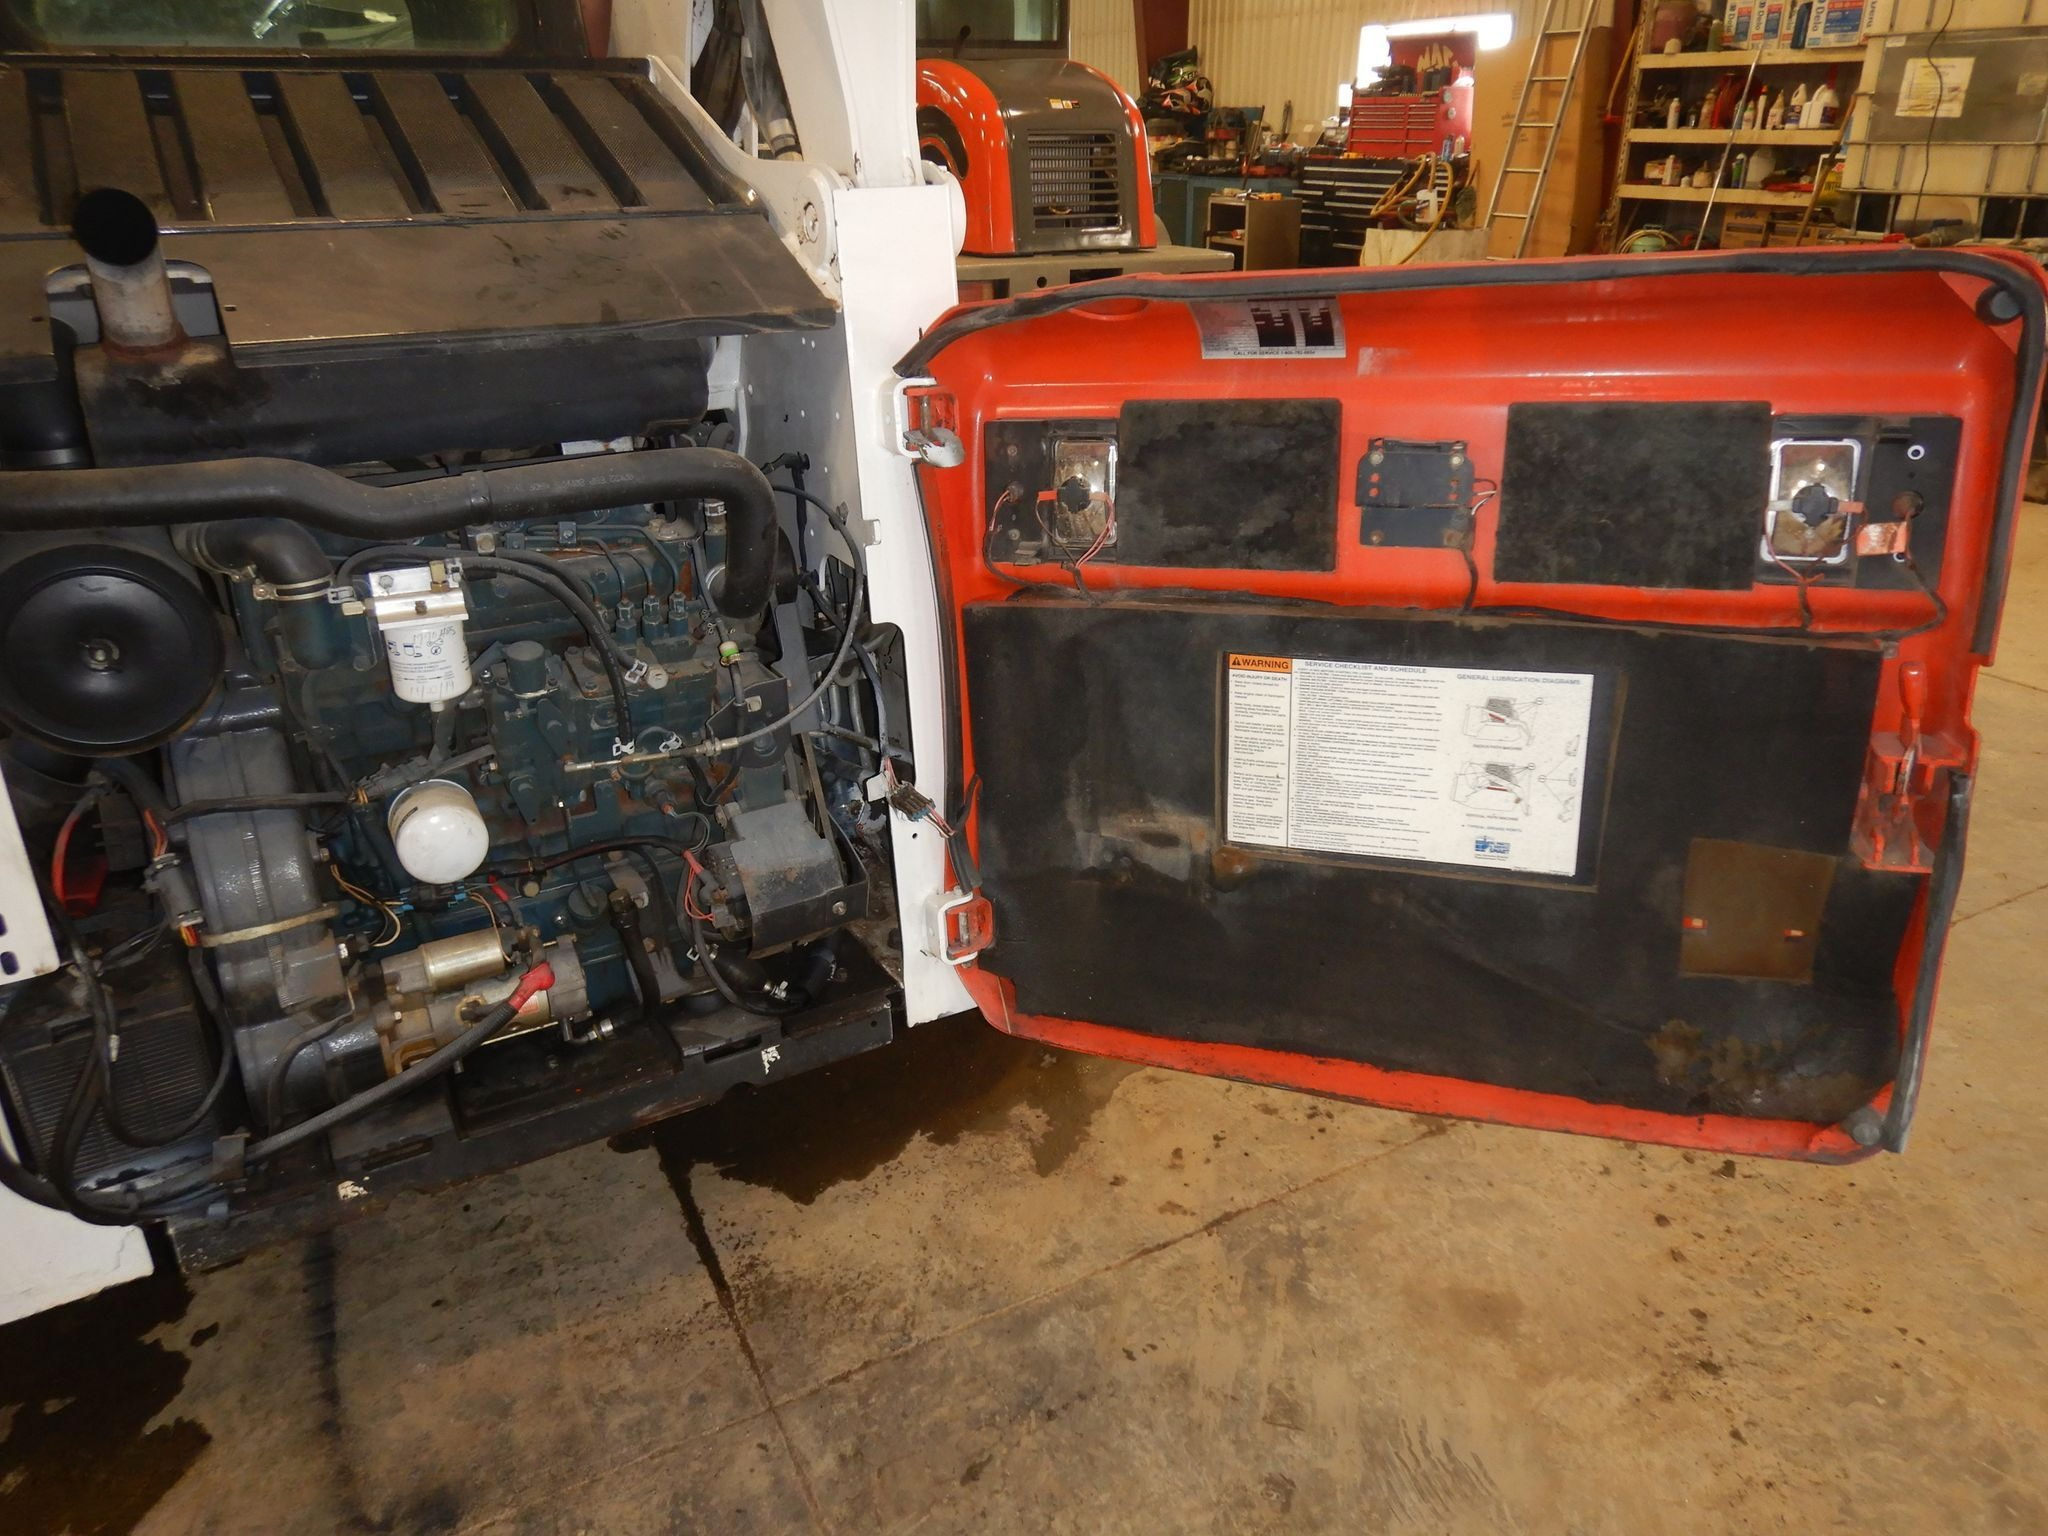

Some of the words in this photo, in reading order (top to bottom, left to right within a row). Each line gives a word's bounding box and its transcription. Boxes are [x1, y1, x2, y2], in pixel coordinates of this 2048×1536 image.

[1812, 6, 1825, 32] Delo
[1242, 658, 1289, 669] WARNING
[1335, 663, 1373, 671] CHECKLIST
[1390, 666, 1427, 674] SCHEDULE
[1457, 673, 1489, 681] GENERAL
[1492, 675, 1540, 683] LUBRICATION
[1542, 677, 1580, 685] DIAGRAMS
